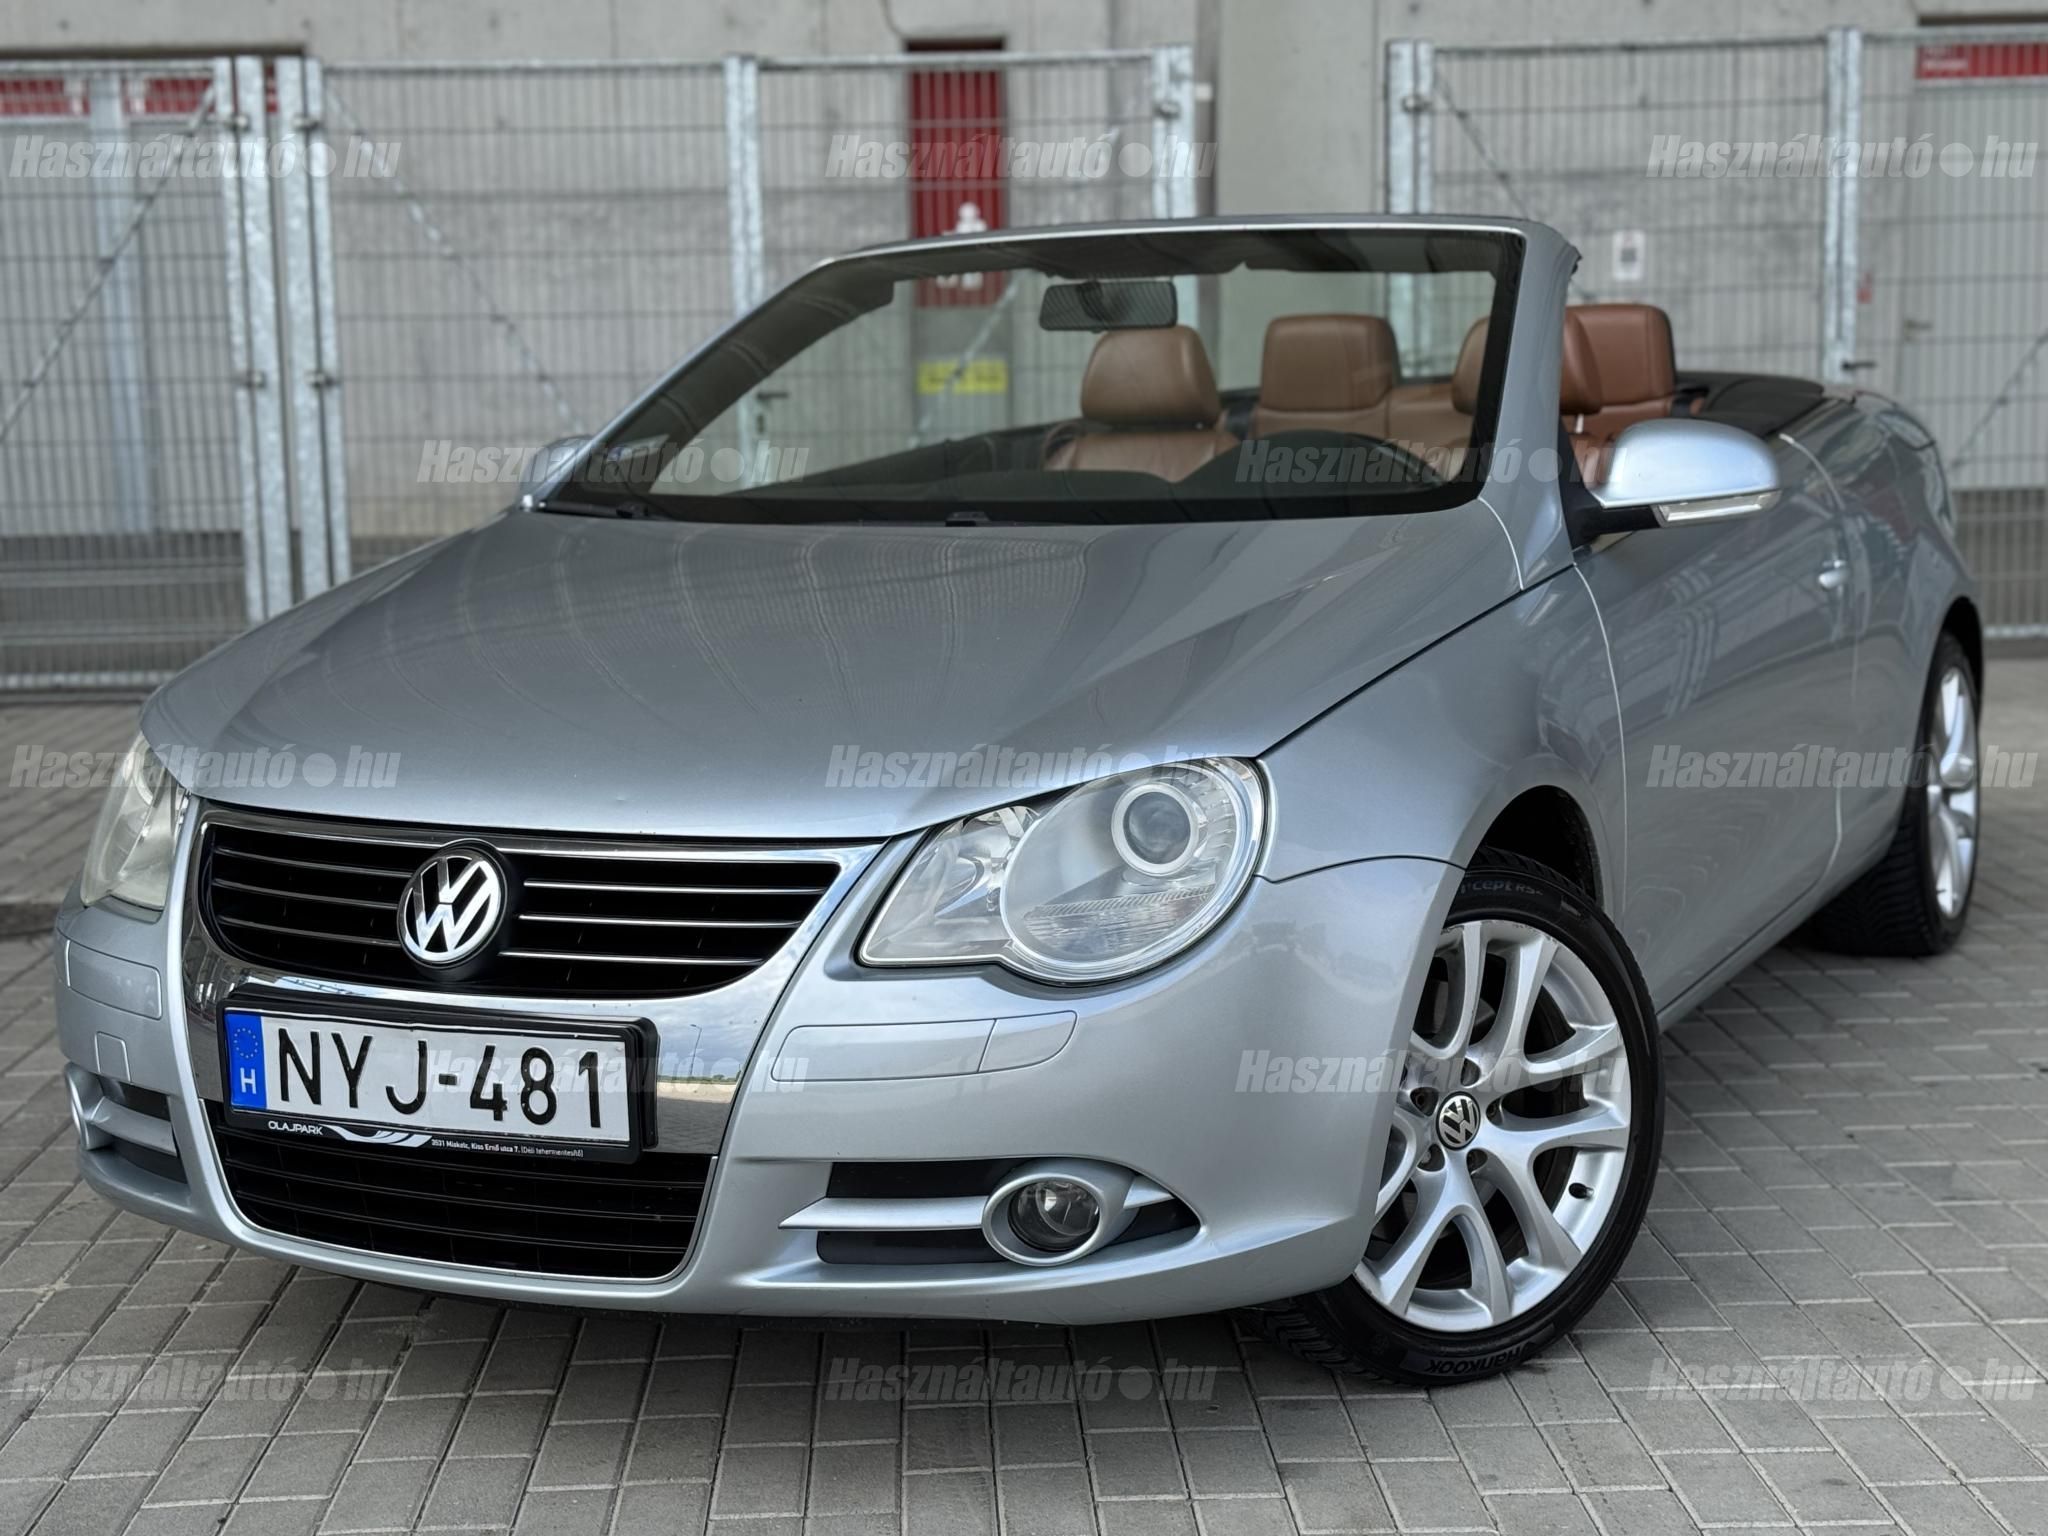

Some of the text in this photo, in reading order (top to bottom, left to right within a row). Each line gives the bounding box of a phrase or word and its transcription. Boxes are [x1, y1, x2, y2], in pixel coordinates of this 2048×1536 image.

[239, 1066, 257, 1096] H
[277, 1027, 602, 1129] NYJ-481
[267, 1120, 324, 1136] OLAJPARK
